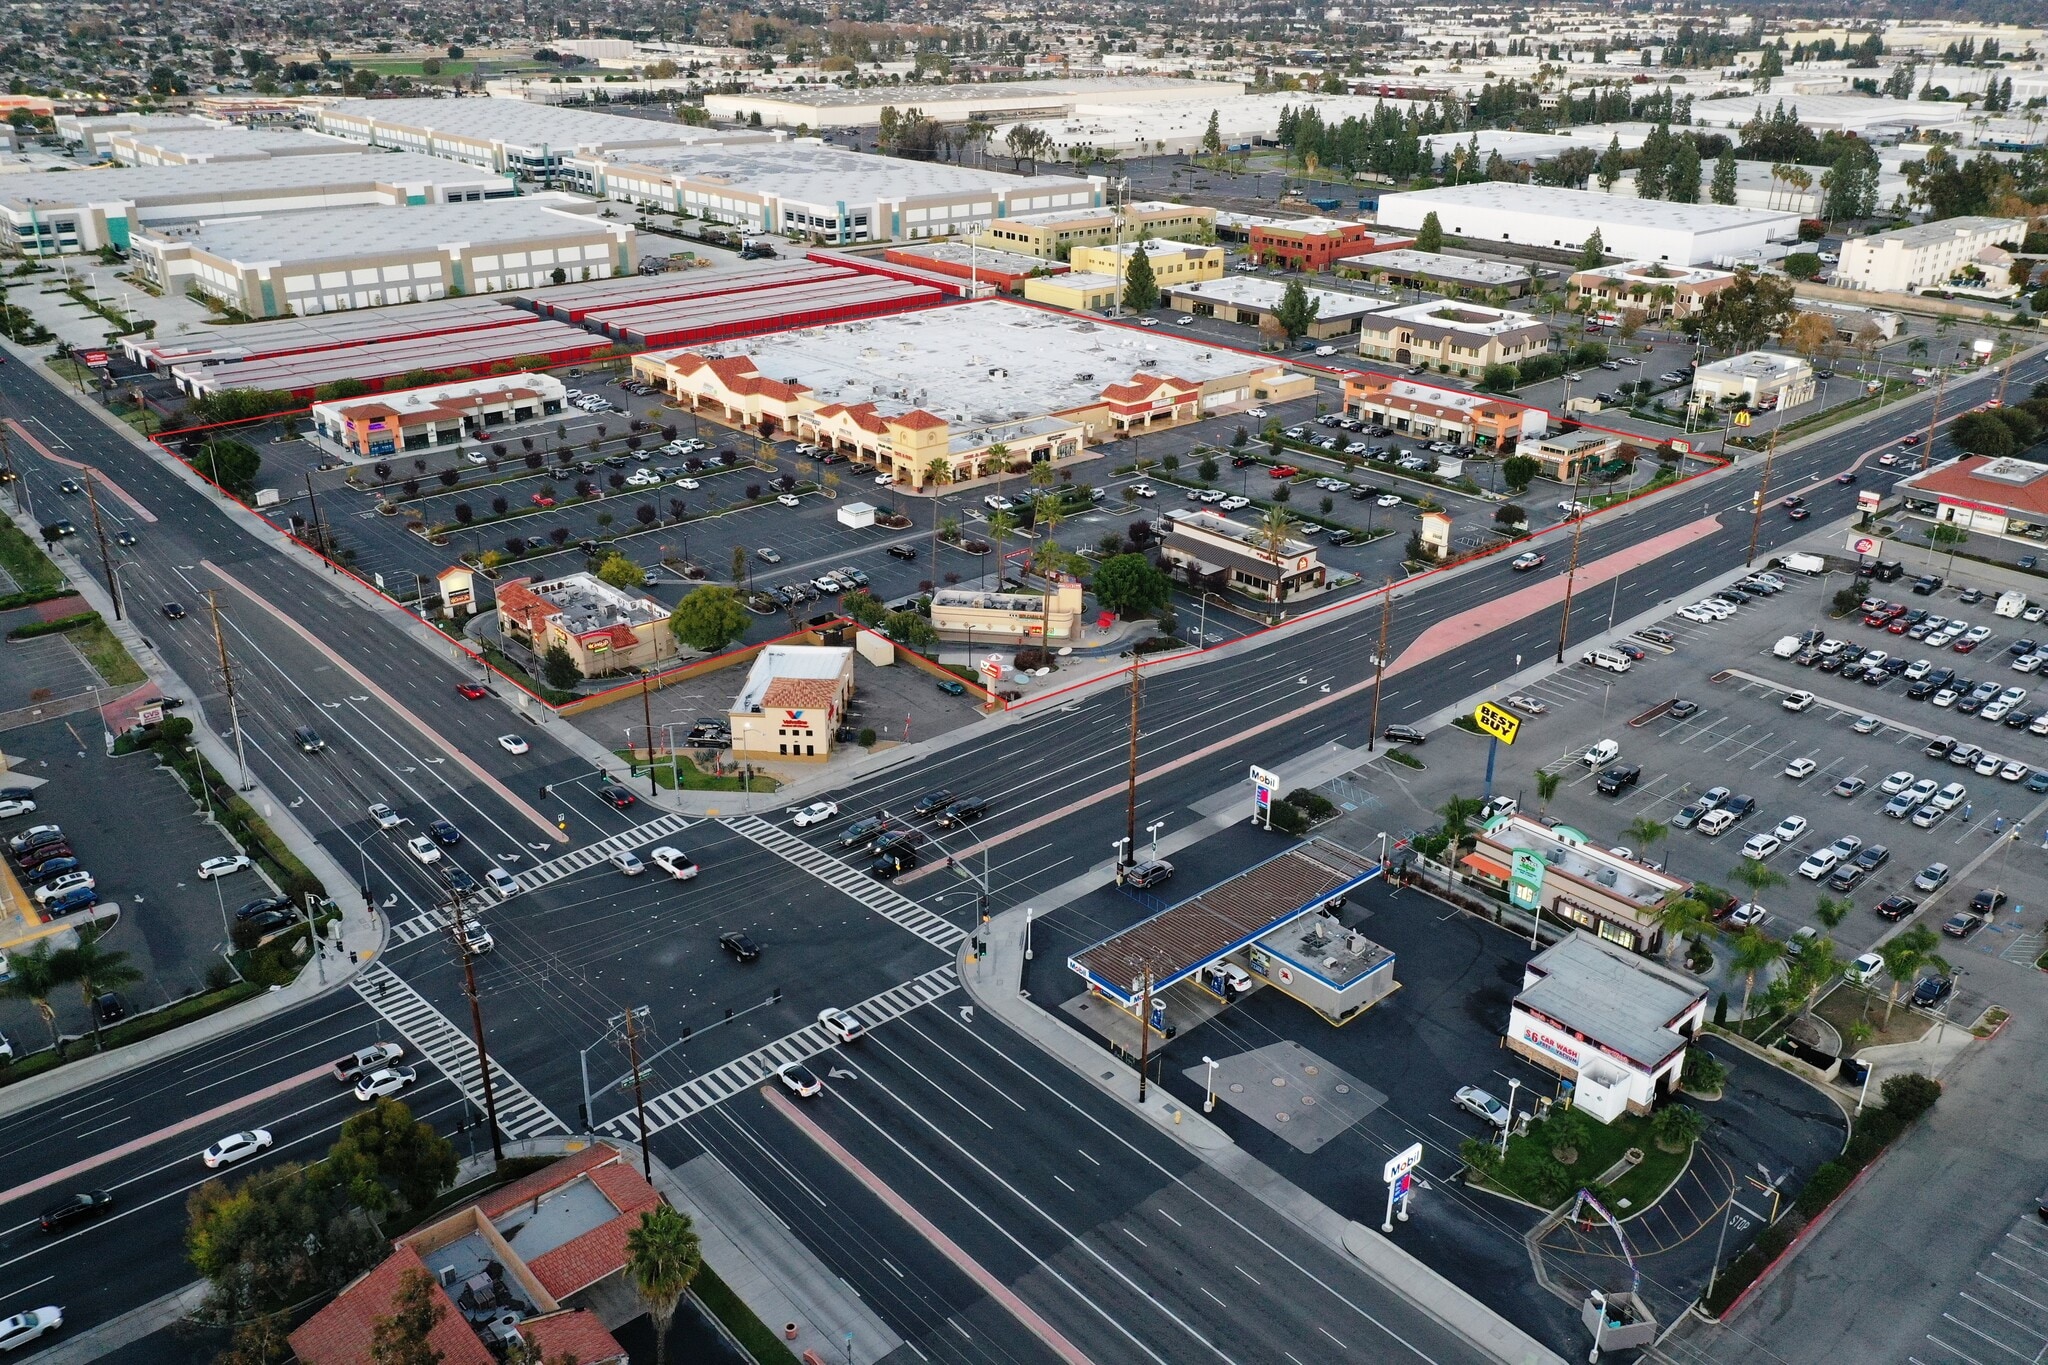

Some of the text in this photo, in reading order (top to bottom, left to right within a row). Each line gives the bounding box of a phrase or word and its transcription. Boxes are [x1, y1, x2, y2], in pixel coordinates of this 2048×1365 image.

[143, 710, 160, 719] CVS
[1480, 705, 1516, 730] BEST
[1480, 714, 1511, 736] BUY
[1251, 769, 1276, 787] Mobil
[1069, 962, 1088, 977] Mobil
[1540, 1035, 1555, 1046] CAR
[1556, 1042, 1578, 1058] WASH
[1555, 1050, 1577, 1063] VACUUM
[1390, 1150, 1420, 1178] Mobil
[1729, 1214, 1750, 1231] STOP
